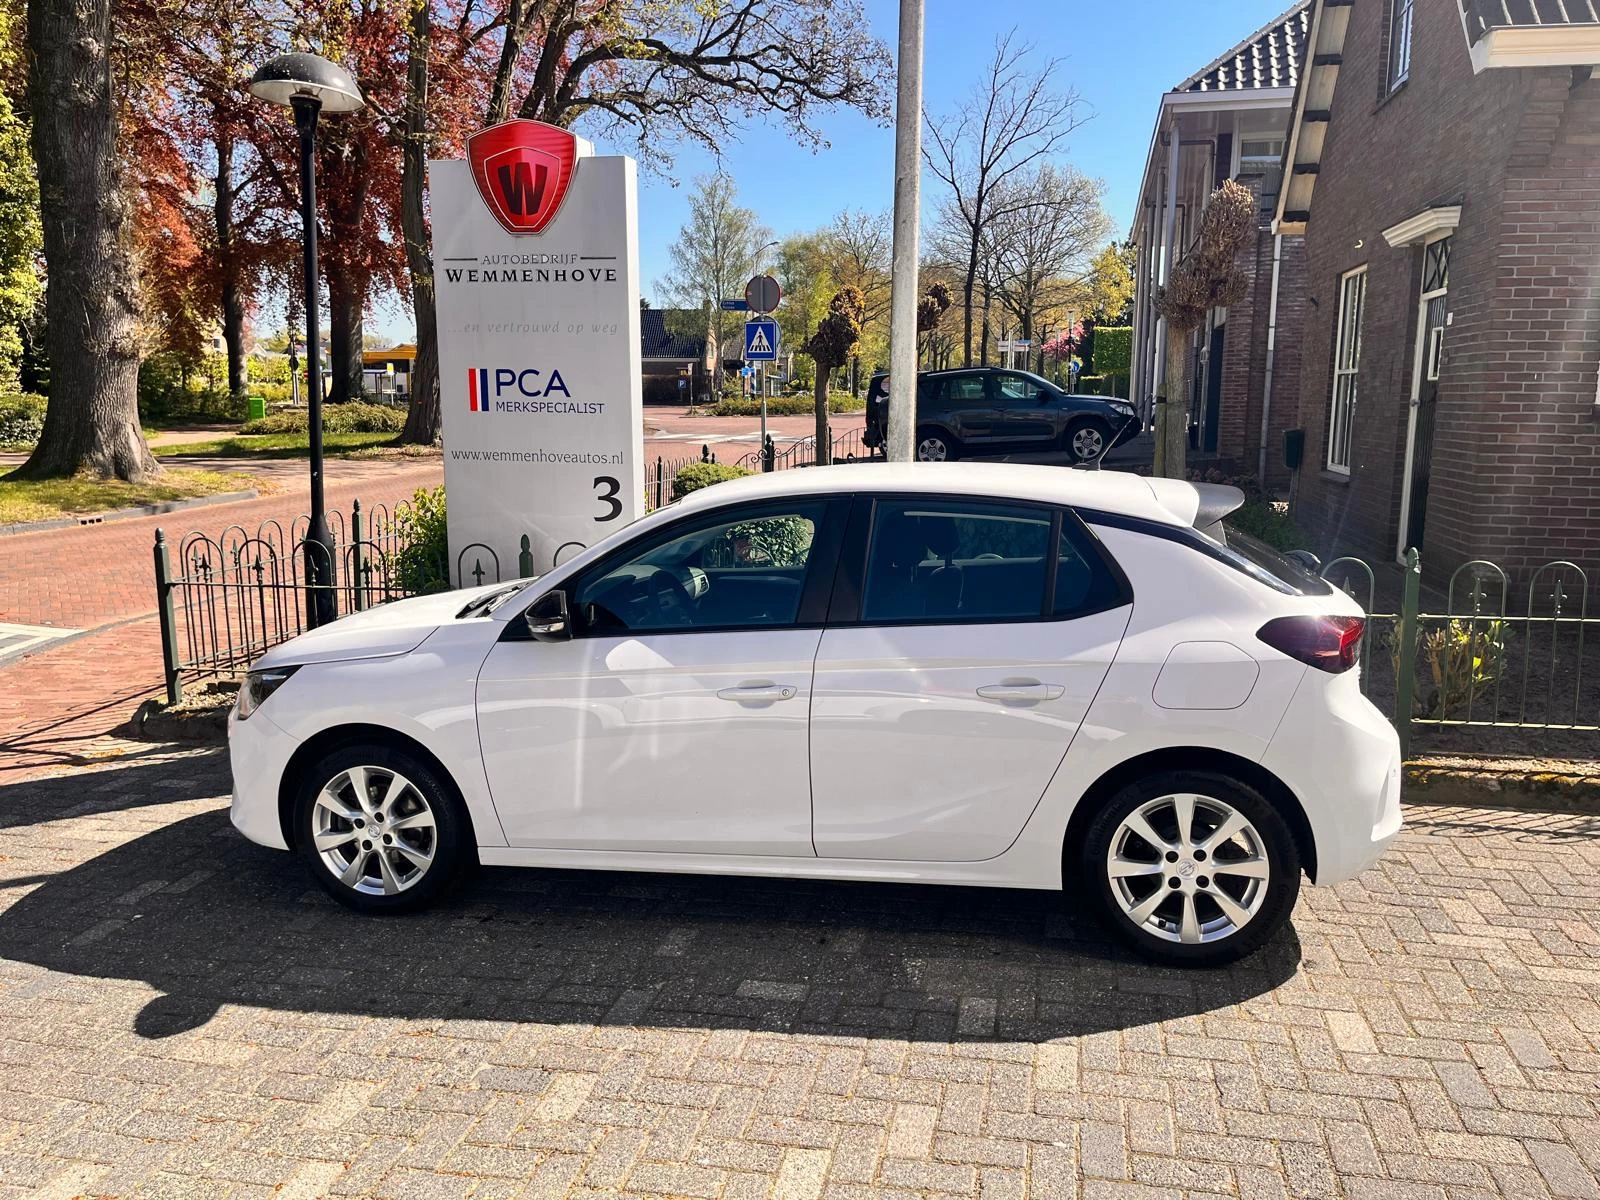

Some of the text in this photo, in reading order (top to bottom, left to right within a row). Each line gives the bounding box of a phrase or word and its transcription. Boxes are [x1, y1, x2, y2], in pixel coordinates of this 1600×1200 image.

[497, 162, 548, 216] W
[482, 253, 578, 266] AUTOBEDRIJF
[446, 268, 617, 283] WEMMENHOVE
[487, 323, 560, 334] vertrouwd
[567, 325, 584, 336] op
[591, 325, 618, 336] weg
[495, 368, 571, 398] PCA
[495, 401, 605, 414] MERKSPECIALIST
[451, 449, 624, 465] www.wemmenhoveautos.nl
[592, 475, 623, 522] 3
